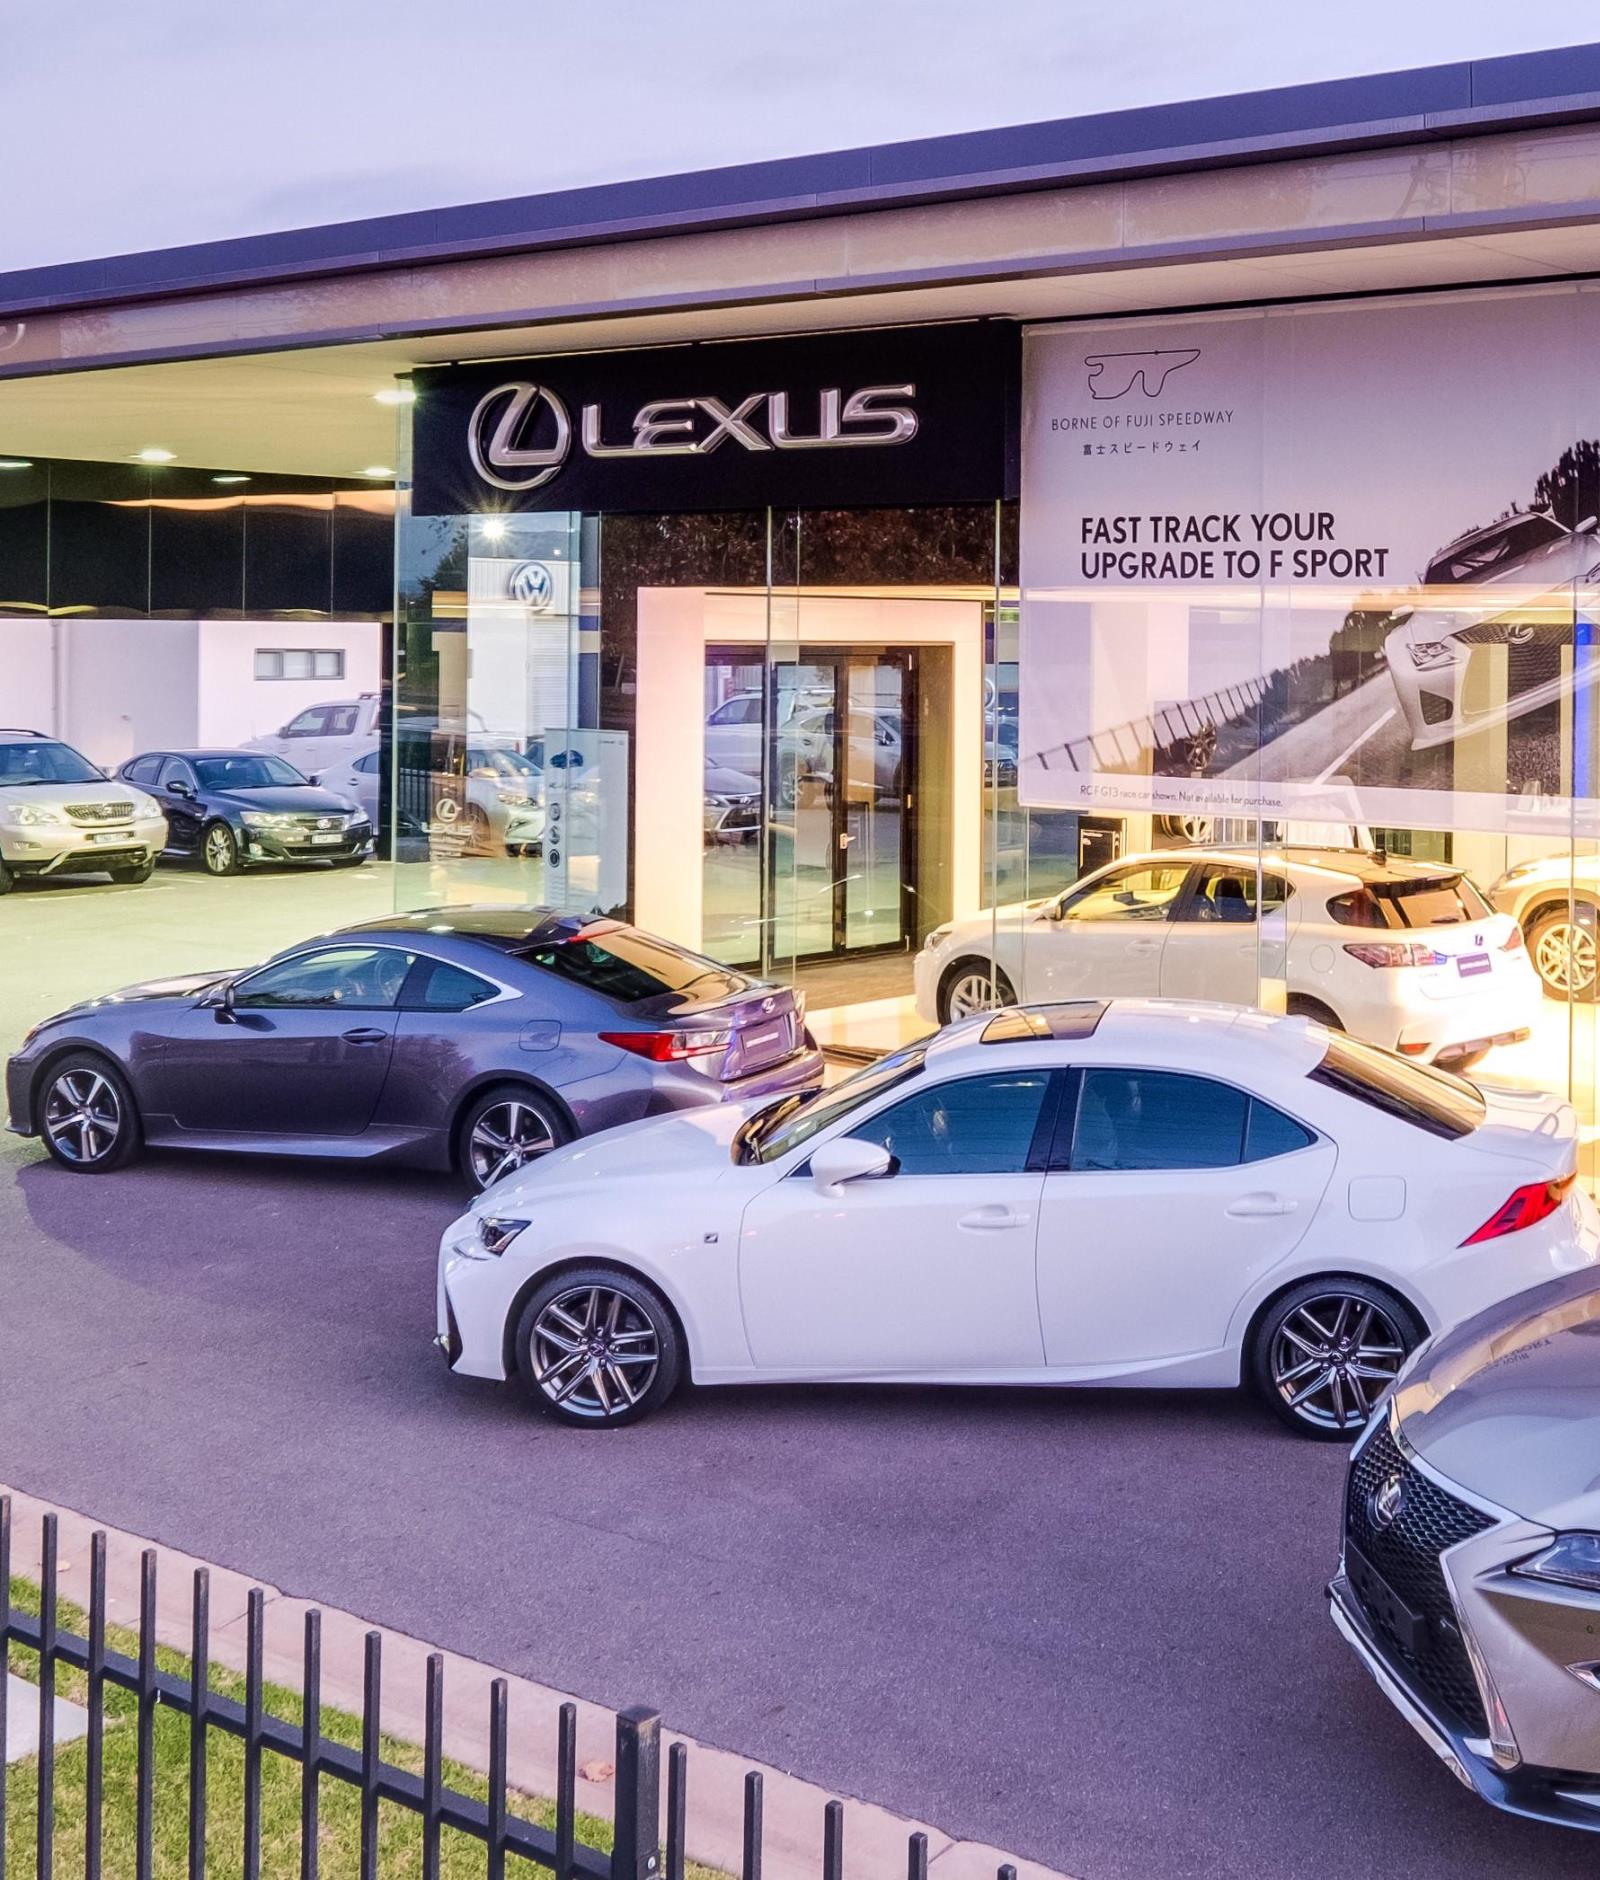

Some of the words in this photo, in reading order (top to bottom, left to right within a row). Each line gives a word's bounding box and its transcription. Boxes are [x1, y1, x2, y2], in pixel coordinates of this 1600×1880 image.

[581, 383, 920, 458] LEXUS
[1051, 416, 1098, 431] BORNE
[1102, 415, 1120, 429] OF
[1126, 414, 1153, 428] FUJI
[1158, 410, 1234, 427] SPEEDWAY
[1082, 439, 1201, 456] 富士スピードウェイ
[1081, 516, 1141, 544] FAST
[1149, 514, 1241, 543] TRACK
[1250, 512, 1335, 542] YOUR
[1081, 551, 1214, 579] UPGRADE
[1223, 550, 1260, 579] TO
[1270, 550, 1283, 578] F
[1292, 548, 1389, 578] SPORT
[1152, 790, 1177, 801] shown.
[1178, 791, 1194, 801] Not
[1230, 793, 1242, 805] for
[1243, 795, 1283, 808] purchase.
